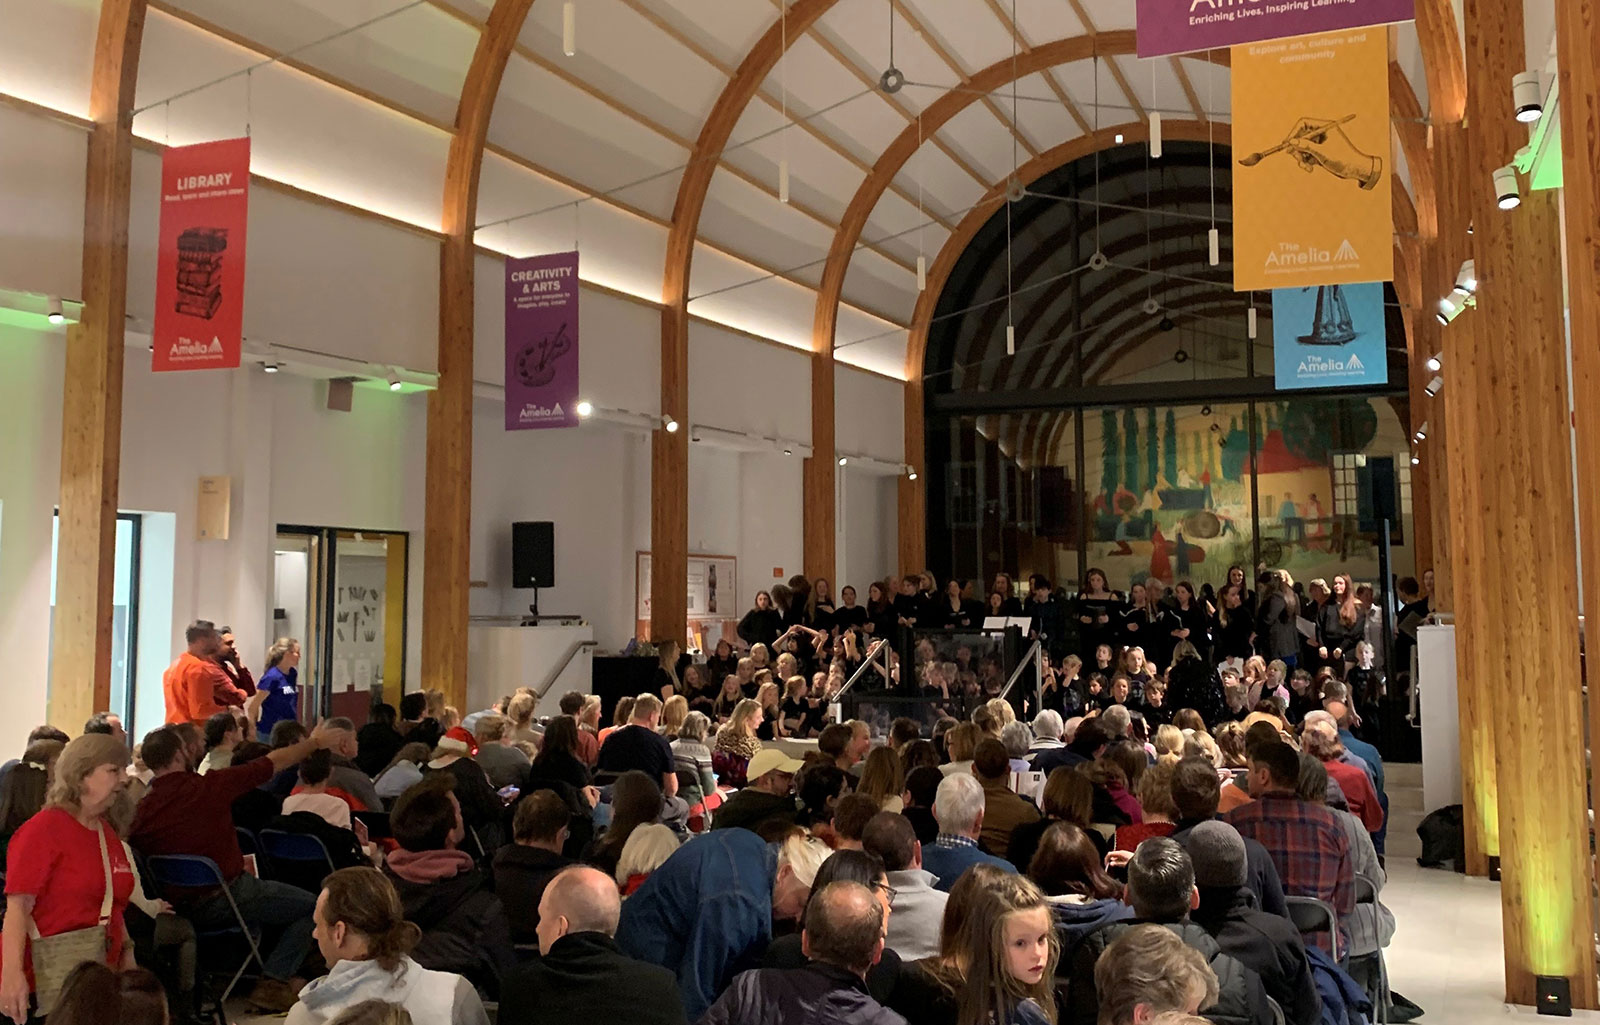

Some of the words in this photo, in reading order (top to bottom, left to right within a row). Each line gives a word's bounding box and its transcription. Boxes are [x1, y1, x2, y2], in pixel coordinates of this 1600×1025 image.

[1189, 11, 1235, 25] Enriching
[1237, 8, 1264, 18] Lives,
[1266, 1, 1309, 13] Inspiring
[1347, 33, 1367, 43] and
[177, 172, 232, 191] LIBRARY
[1279, 242, 1299, 251] The
[1264, 247, 1330, 267] Amelia
[511, 266, 572, 282] CREATIVITY
[523, 283, 530, 294] &
[532, 280, 560, 292] ARTS
[170, 340, 207, 356] Amelia
[1297, 358, 1344, 373] Amelia
[520, 406, 551, 418] Amelia
